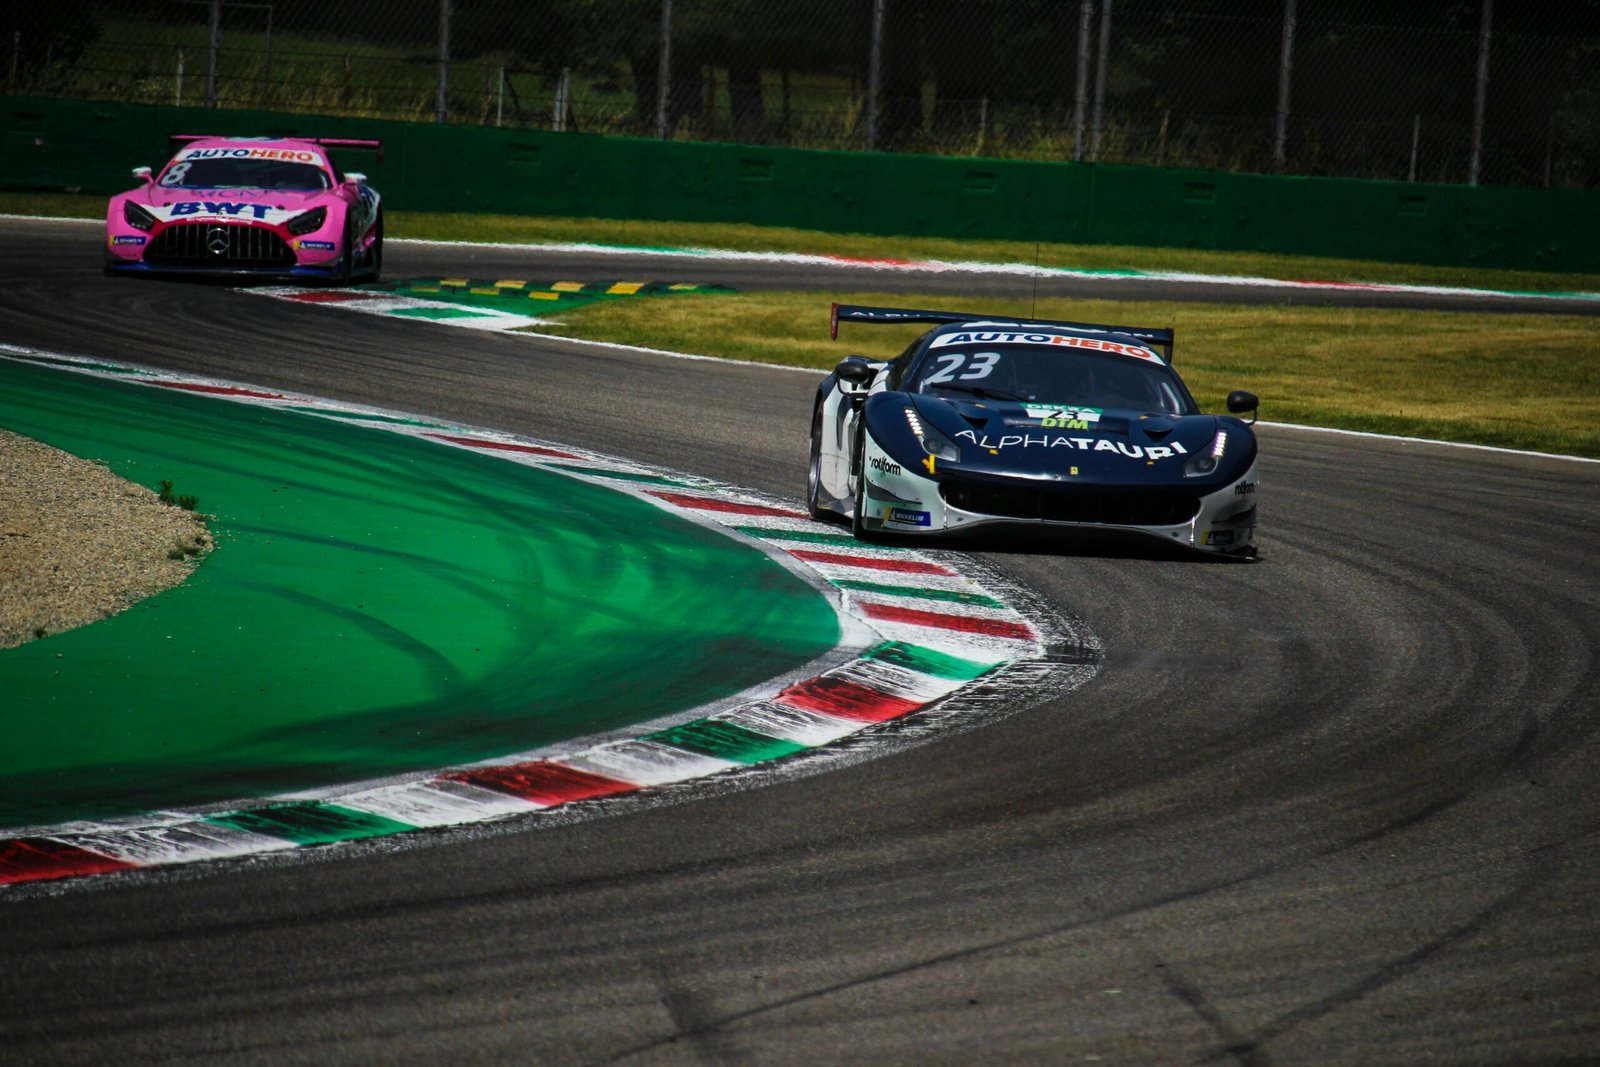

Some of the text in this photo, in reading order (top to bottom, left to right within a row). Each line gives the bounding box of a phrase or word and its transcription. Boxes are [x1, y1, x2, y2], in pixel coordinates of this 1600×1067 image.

[186, 149, 314, 161] AUTOHERO
[160, 161, 193, 185] 8
[170, 201, 273, 219] BWT
[945, 333, 1152, 359] AUTOHERO
[924, 352, 1001, 385] 23
[1041, 417, 1089, 430] DTM
[954, 429, 1188, 461] ALPHATAURI
[870, 455, 901, 476] rotiform
[895, 512, 926, 522] MICHELIN
